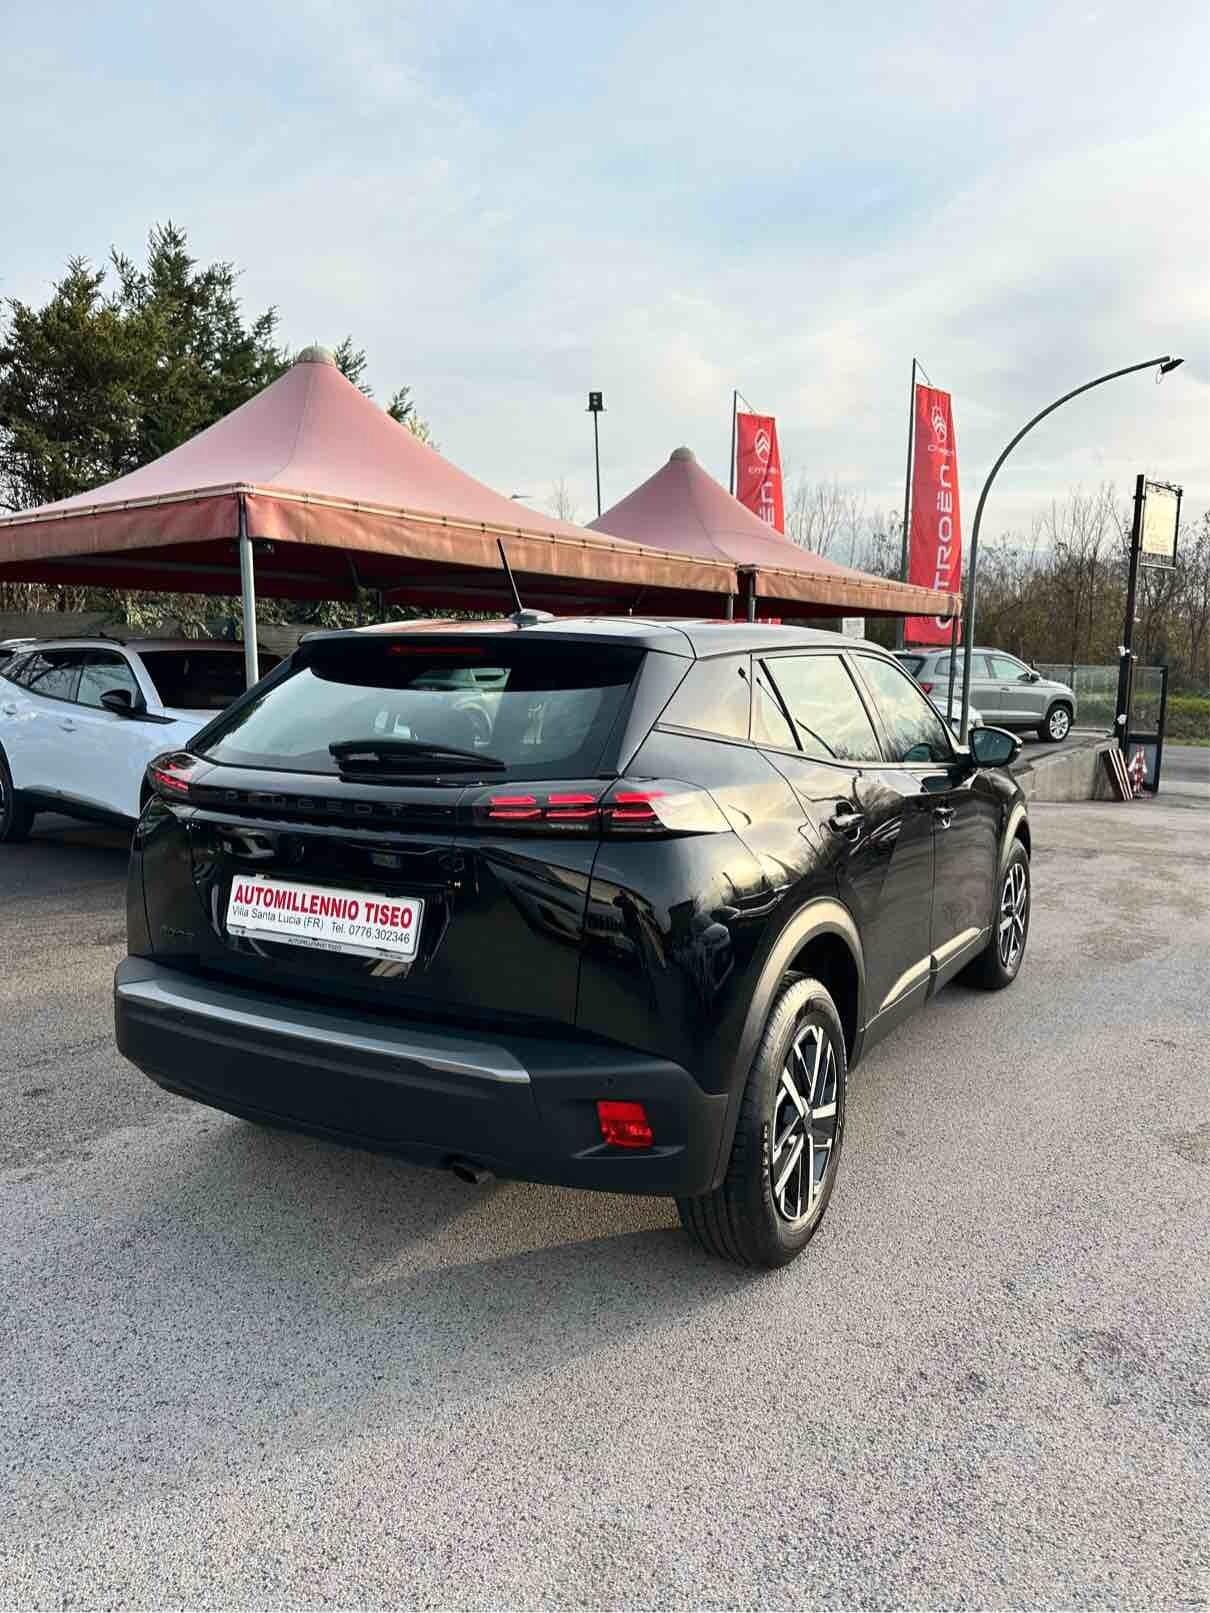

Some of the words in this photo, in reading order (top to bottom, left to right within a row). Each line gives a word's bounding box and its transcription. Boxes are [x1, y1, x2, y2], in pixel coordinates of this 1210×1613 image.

[232, 905, 249, 919] Villa
[251, 907, 276, 922] Santa
[278, 911, 302, 926] Lucia
[303, 915, 324, 930] (FR)
[349, 924, 410, 944] 0776.302346
[234, 884, 359, 921] AUTOMILLENNIO
[364, 901, 412, 929] TISEO
